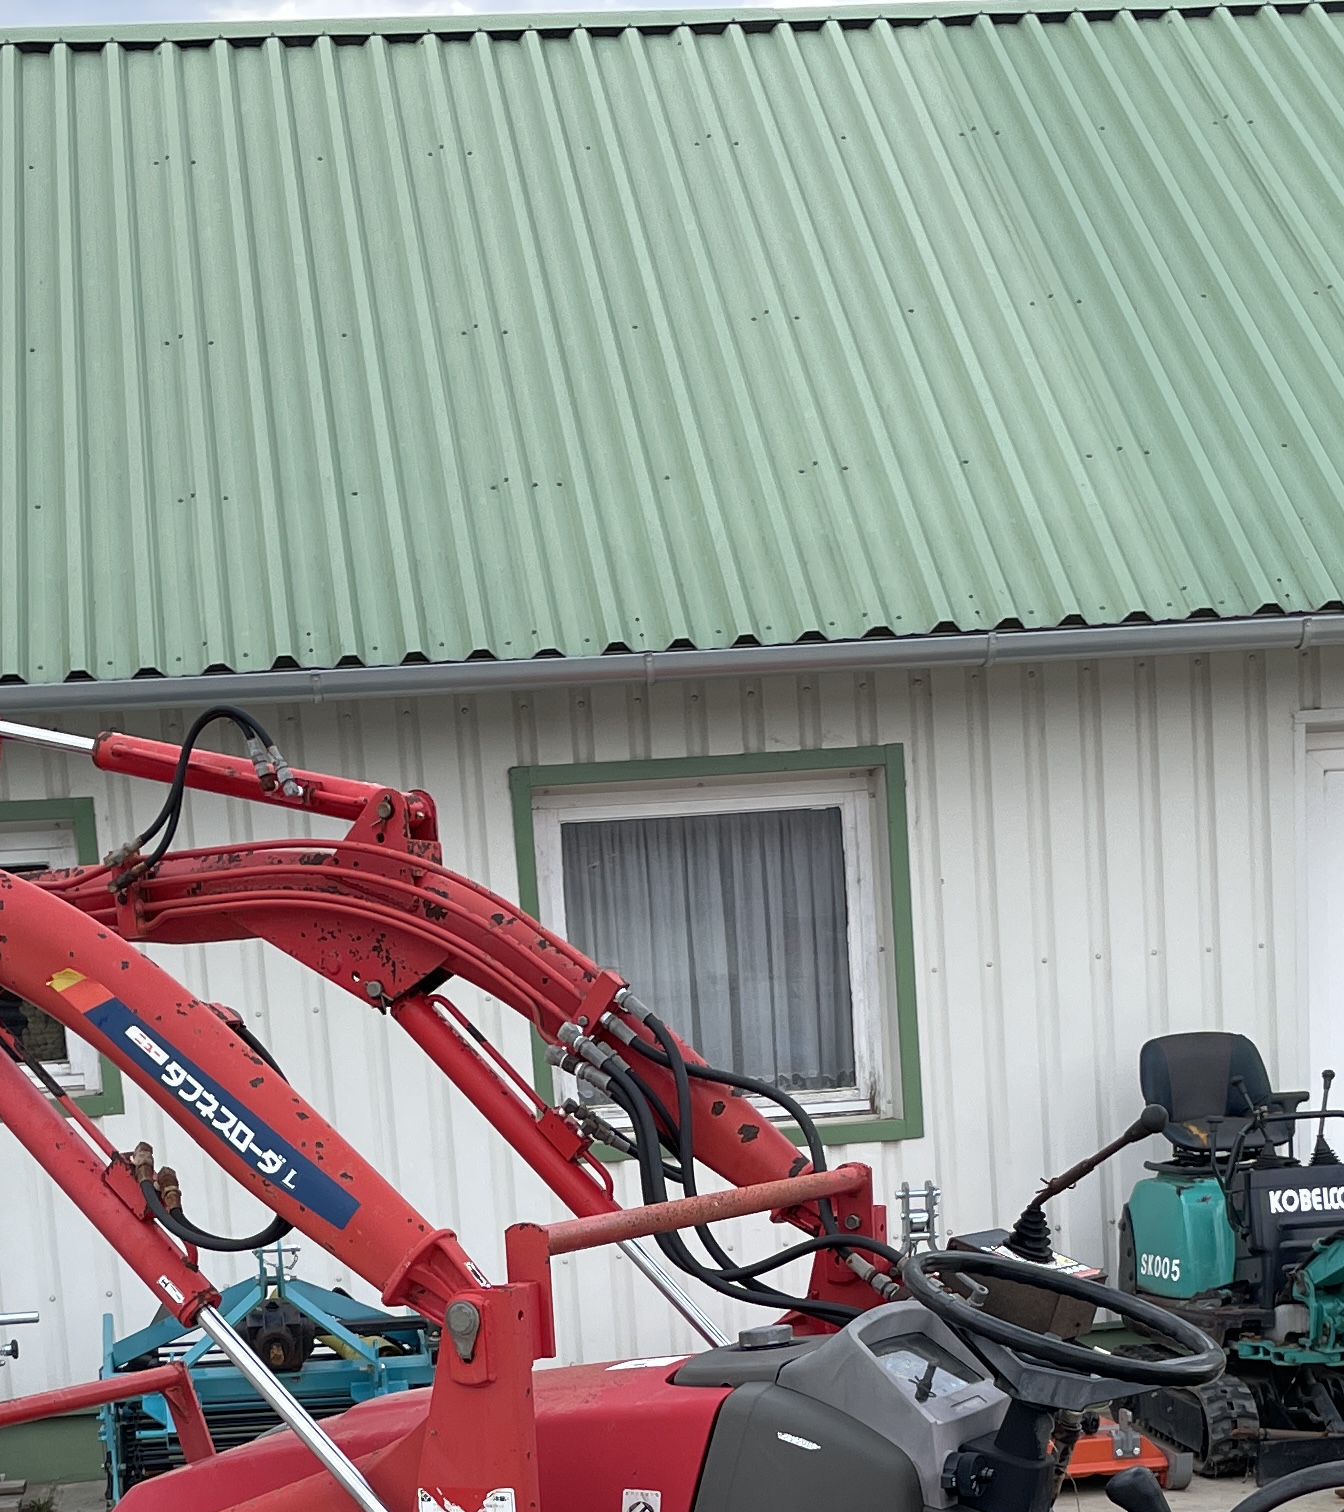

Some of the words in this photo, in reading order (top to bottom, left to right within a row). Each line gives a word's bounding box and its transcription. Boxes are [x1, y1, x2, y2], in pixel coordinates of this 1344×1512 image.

[134, 1032, 161, 1057] ニュー
[282, 1168, 298, 1189] L
[1141, 1253, 1181, 1282] SK005
